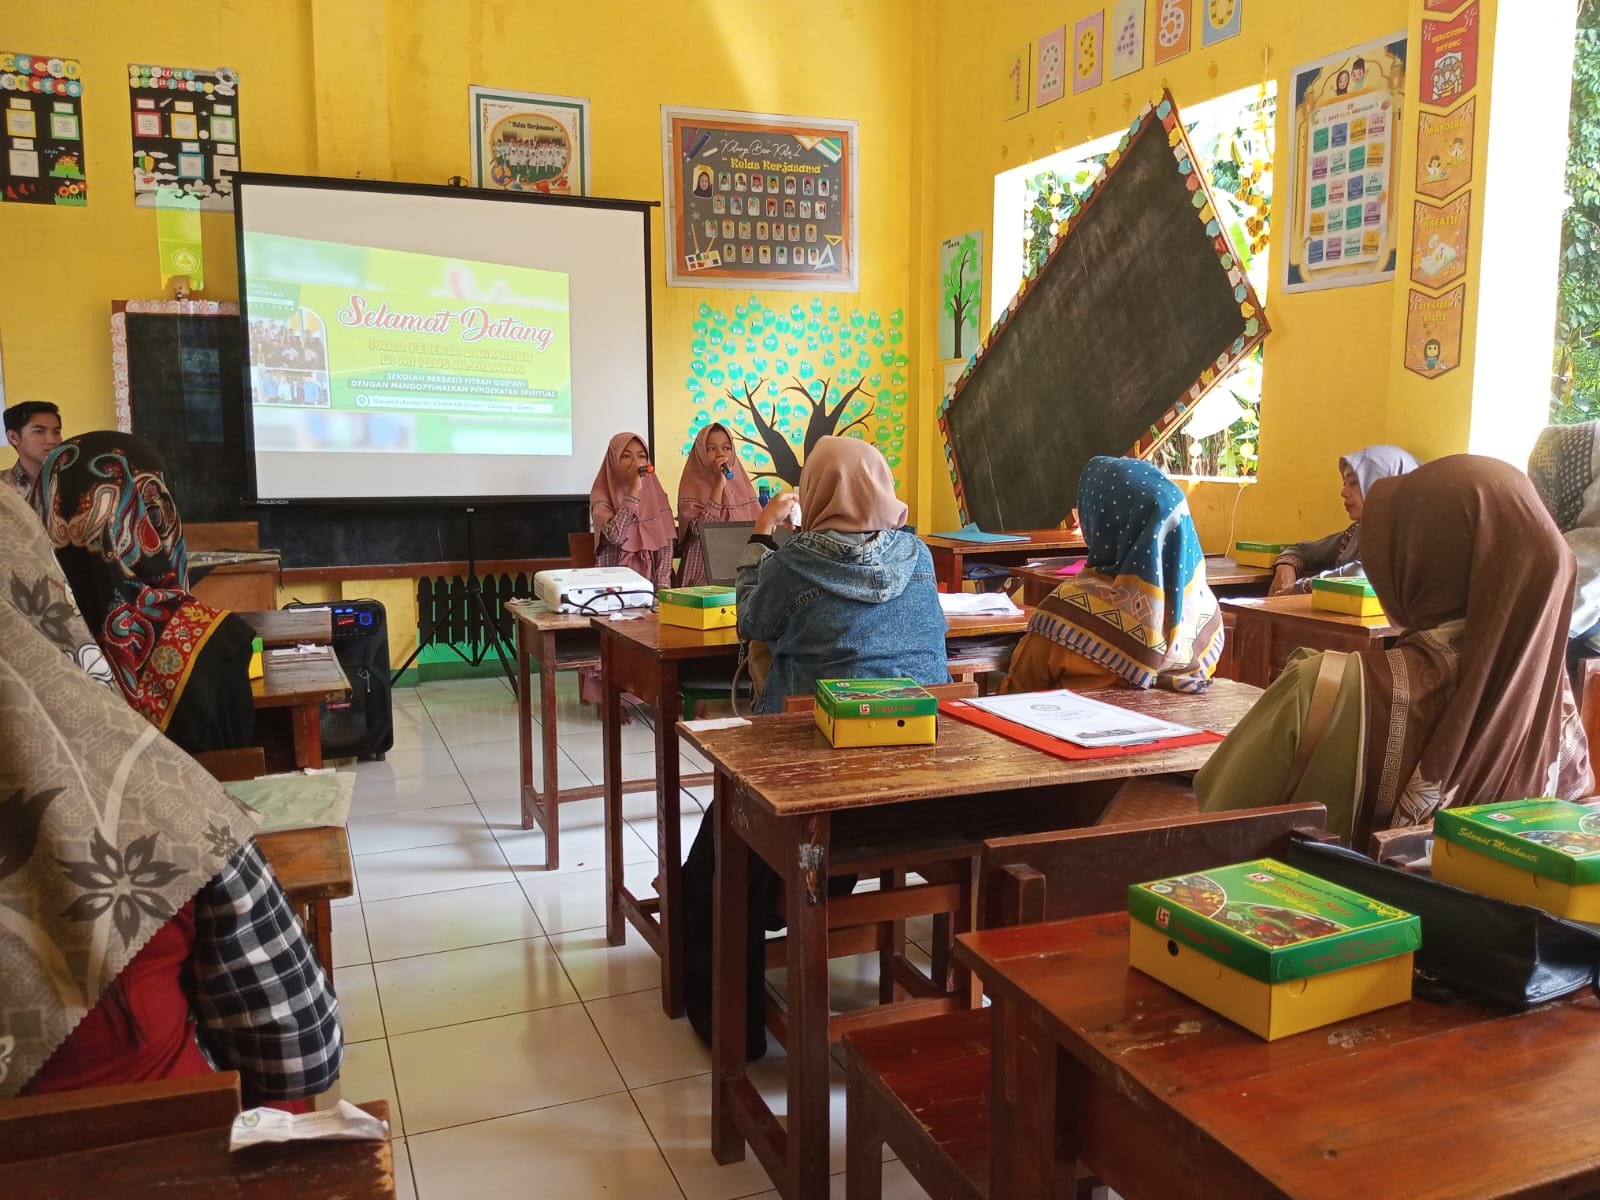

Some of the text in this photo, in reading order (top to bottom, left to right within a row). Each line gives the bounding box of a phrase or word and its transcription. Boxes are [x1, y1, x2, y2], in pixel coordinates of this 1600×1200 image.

[730, 157, 821, 174] Kelas Kerjasama
[338, 294, 554, 351] Selamat Datang
[386, 372, 426, 382] SEKOLAH
[426, 374, 464, 384] BERBASIS
[350, 379, 556, 398] DENGAN MENGOPTIMALKAN PENDEKATAN SPIRITUAL
[1457, 827, 1540, 862] Selamat Menikmati
